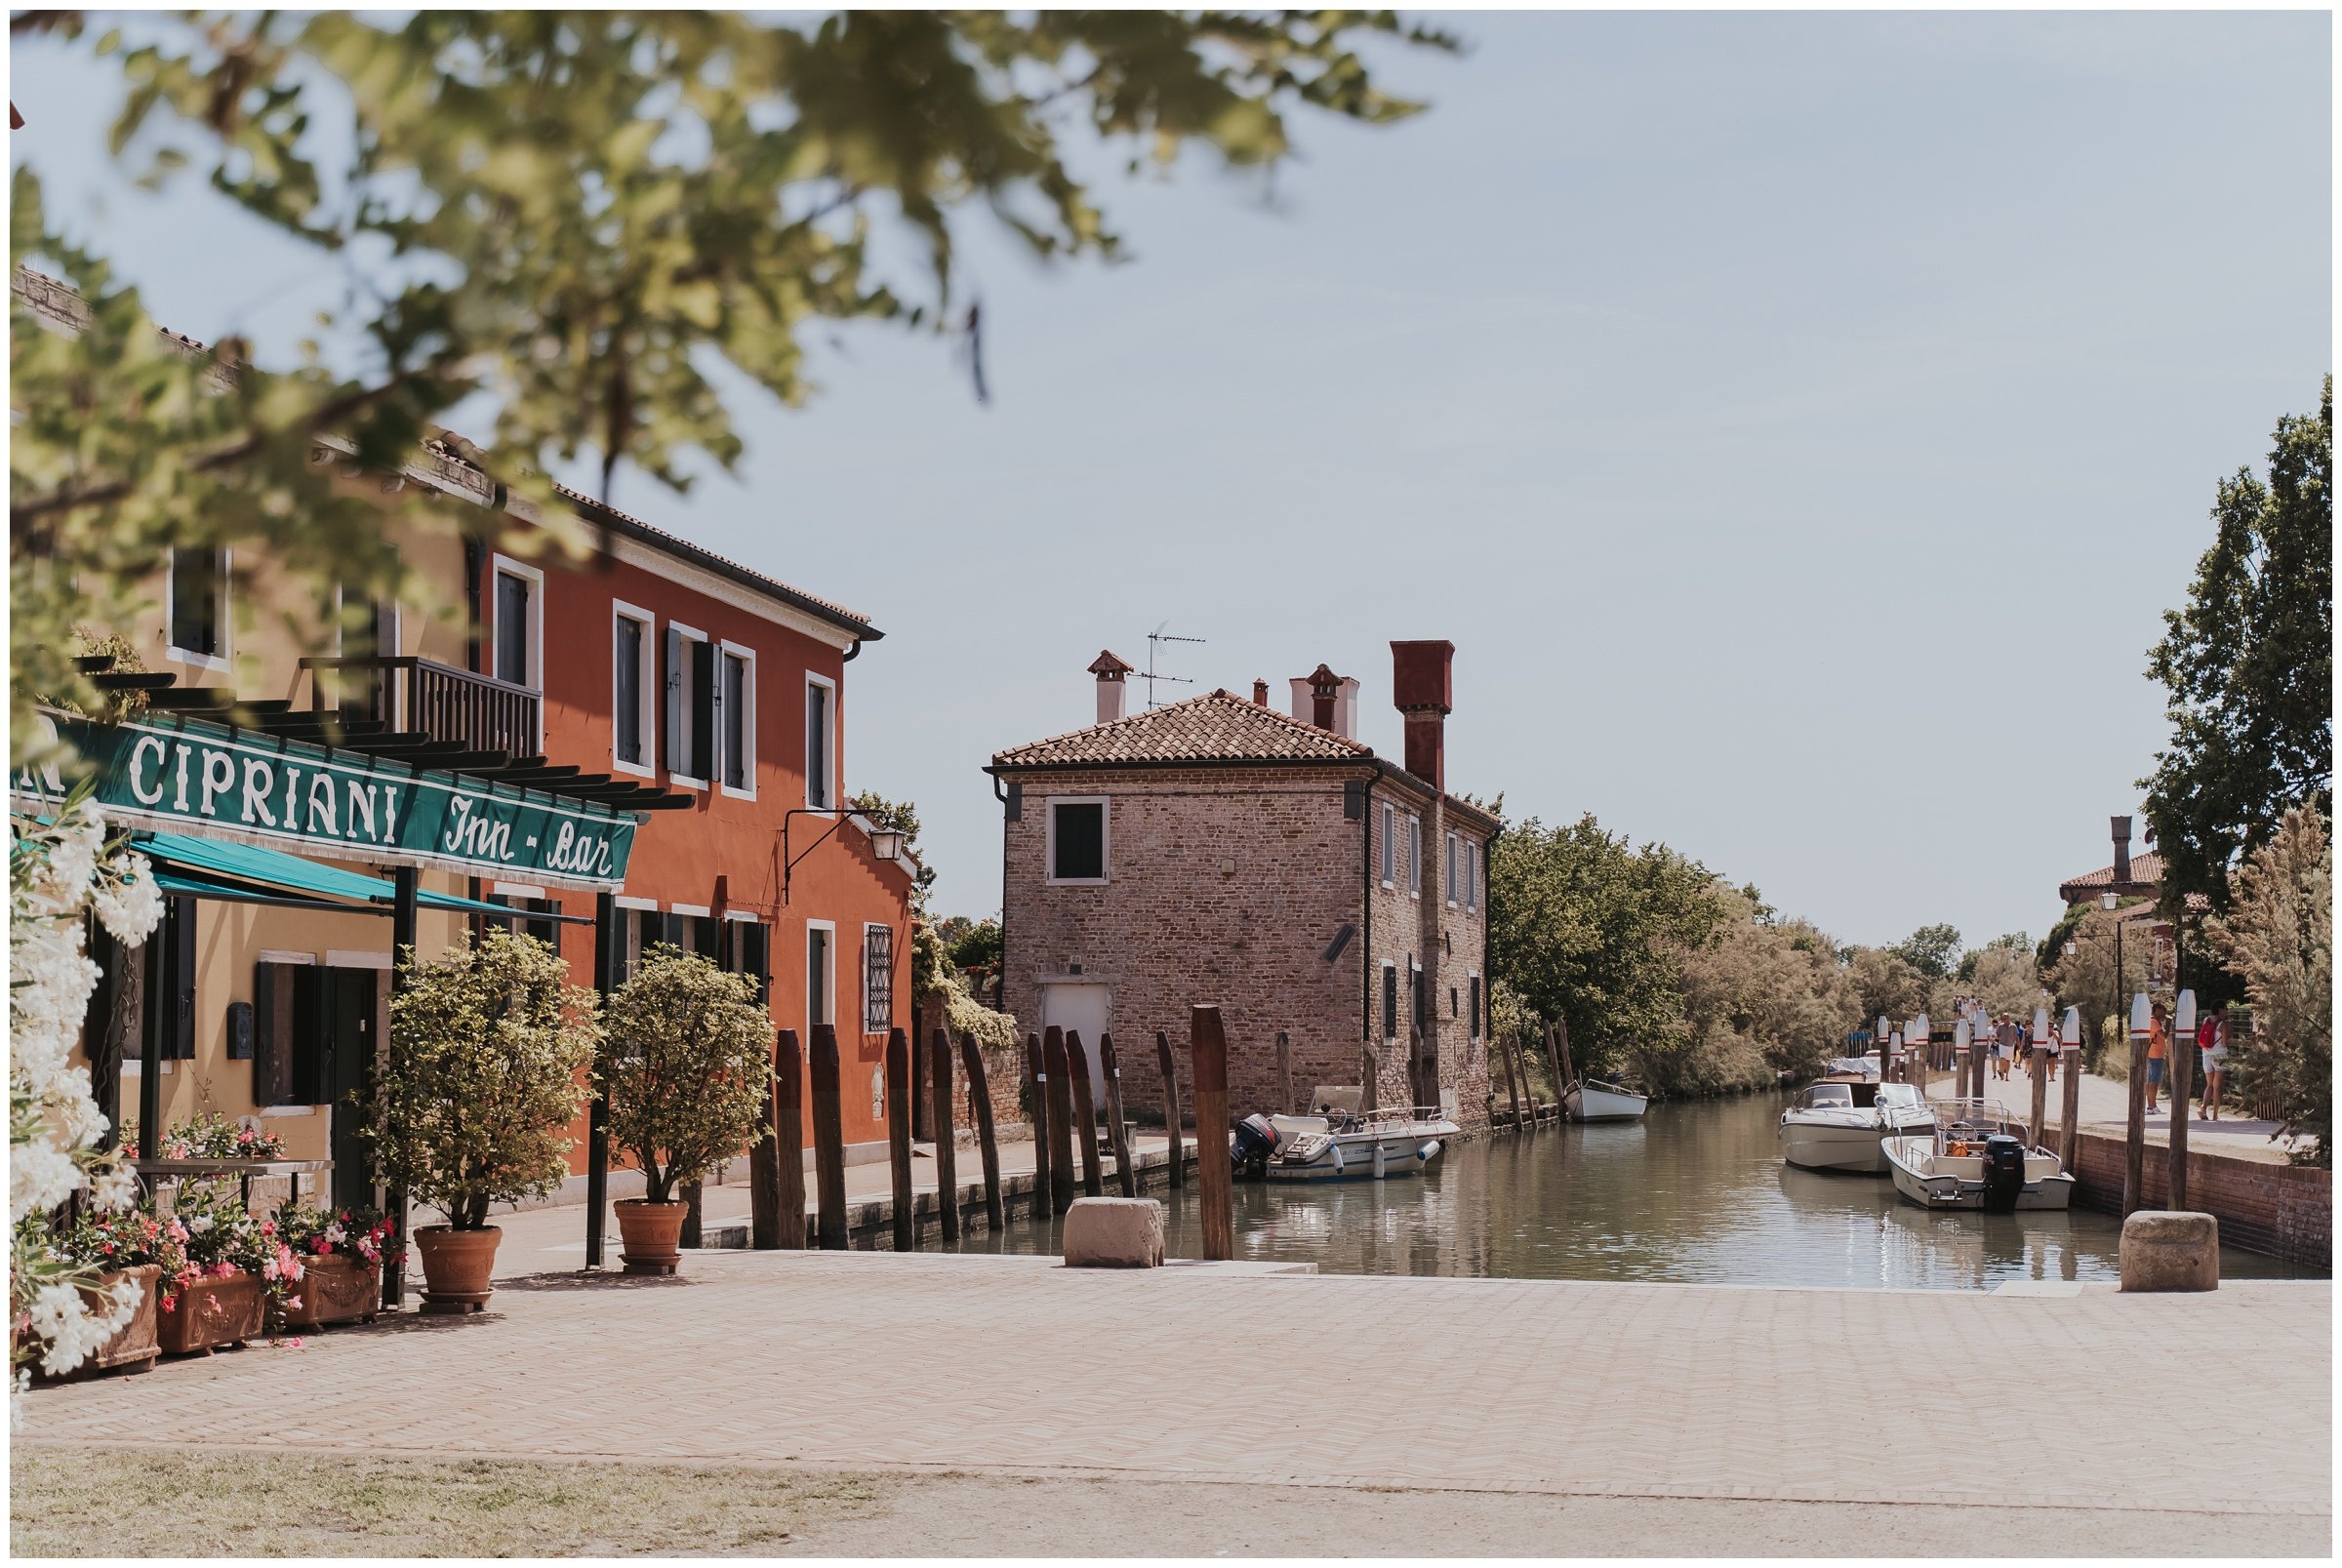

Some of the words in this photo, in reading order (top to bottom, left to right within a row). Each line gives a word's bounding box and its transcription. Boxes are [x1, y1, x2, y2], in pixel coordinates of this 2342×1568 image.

[129, 735, 398, 844] CIPRIANI
[445, 795, 514, 861] Inn
[546, 821, 612, 876] Bar
